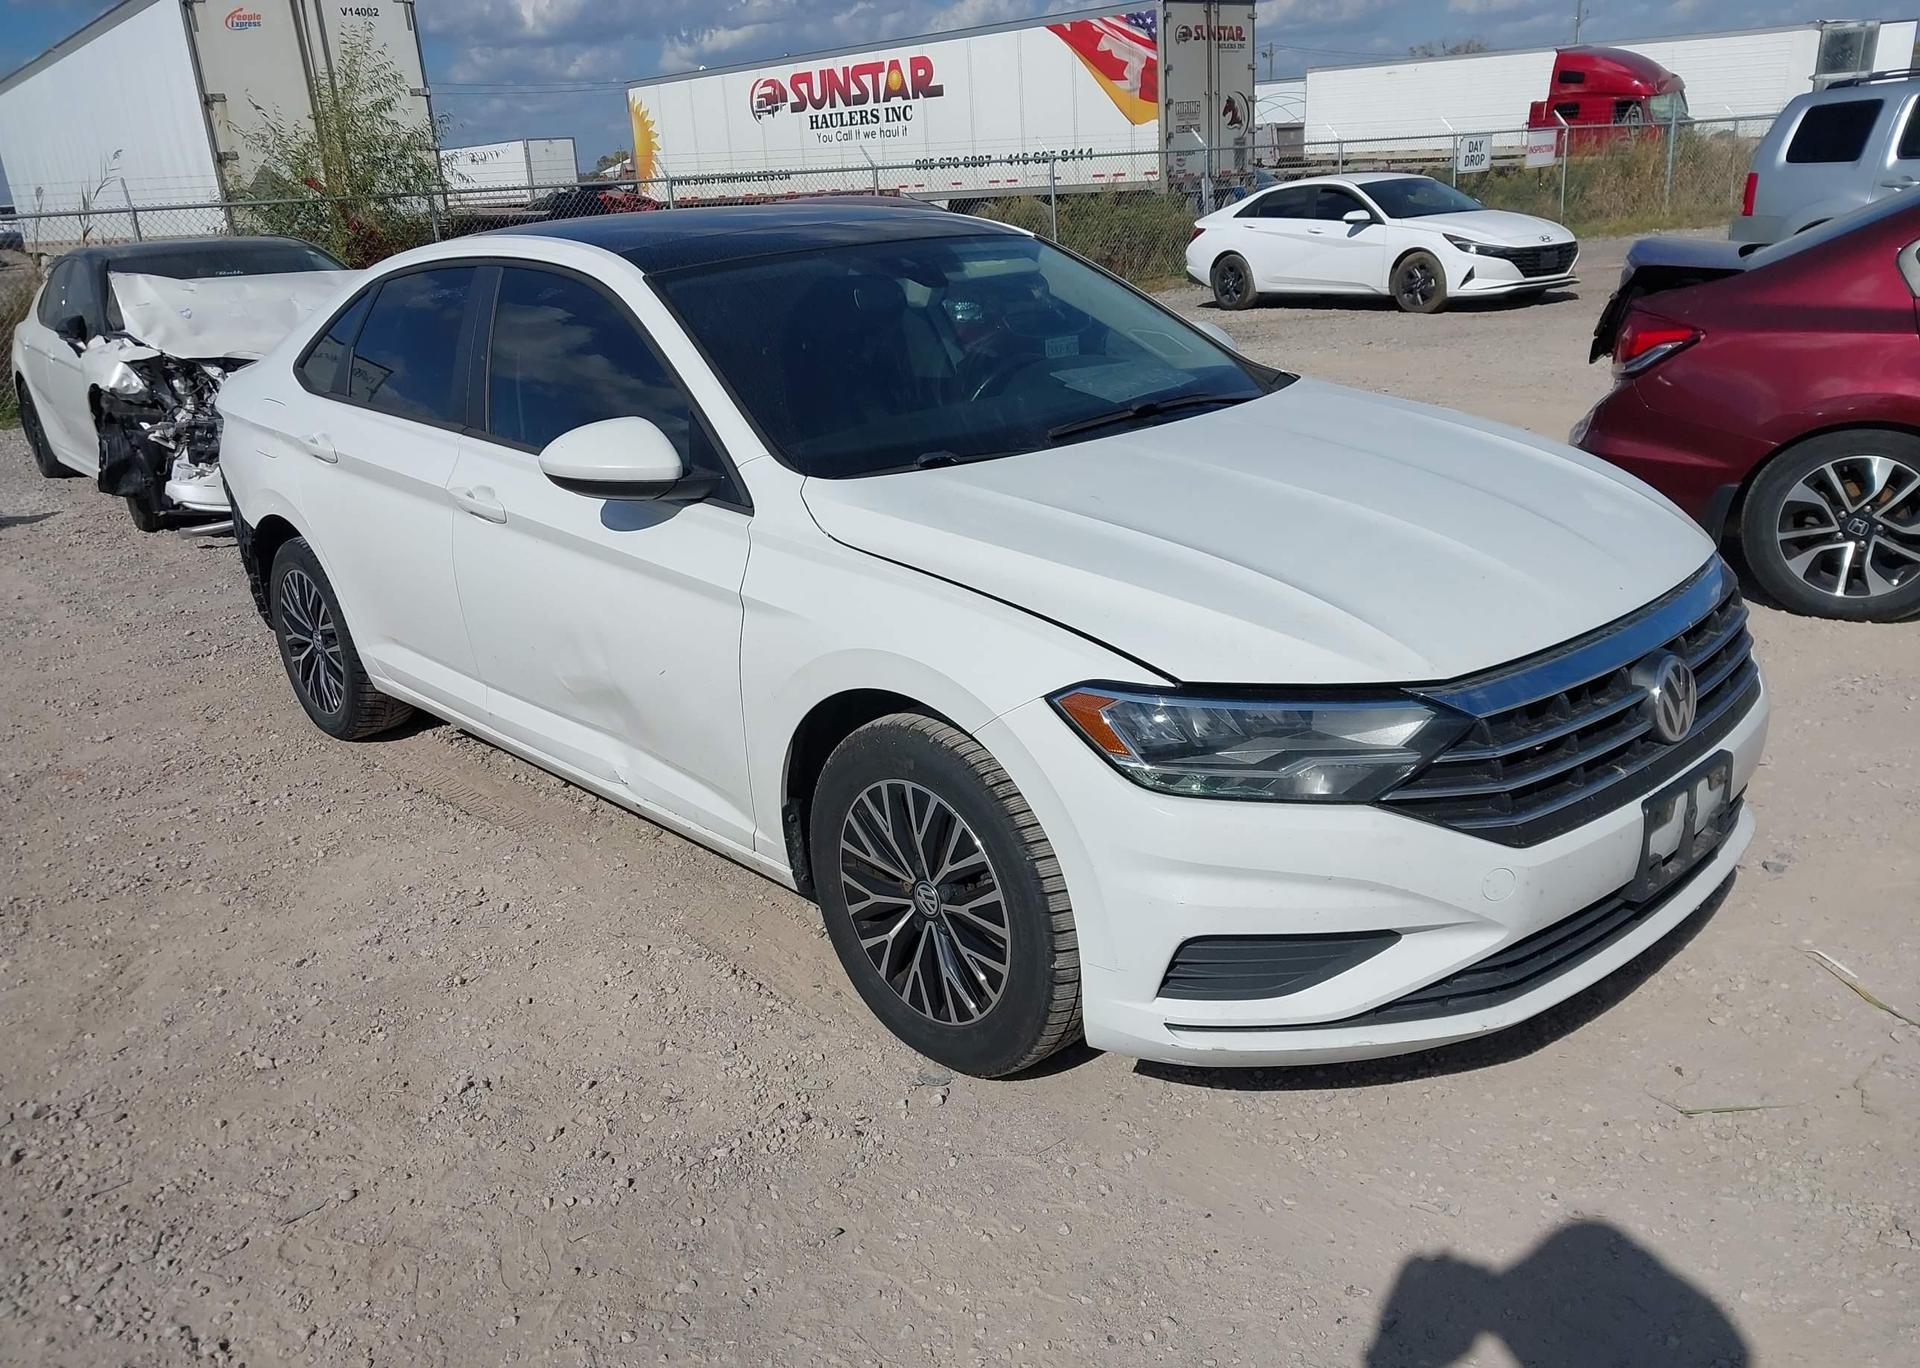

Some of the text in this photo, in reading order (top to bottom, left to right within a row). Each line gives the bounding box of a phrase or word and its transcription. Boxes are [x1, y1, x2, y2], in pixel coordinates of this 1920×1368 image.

[231, 12, 262, 22] People
[340, 7, 379, 17] V14002
[231, 20, 262, 28] Express
[790, 55, 944, 114] SUNSTAR
[1176, 102, 1200, 115] HIRING
[809, 104, 913, 130] HAULERS INC
[816, 132, 833, 144] You
[836, 130, 851, 142] Call
[864, 131, 877, 140] we
[879, 126, 900, 139] haul
[902, 125, 908, 137] it
[1468, 140, 1485, 153] DAY
[1464, 153, 1486, 167] DROP
